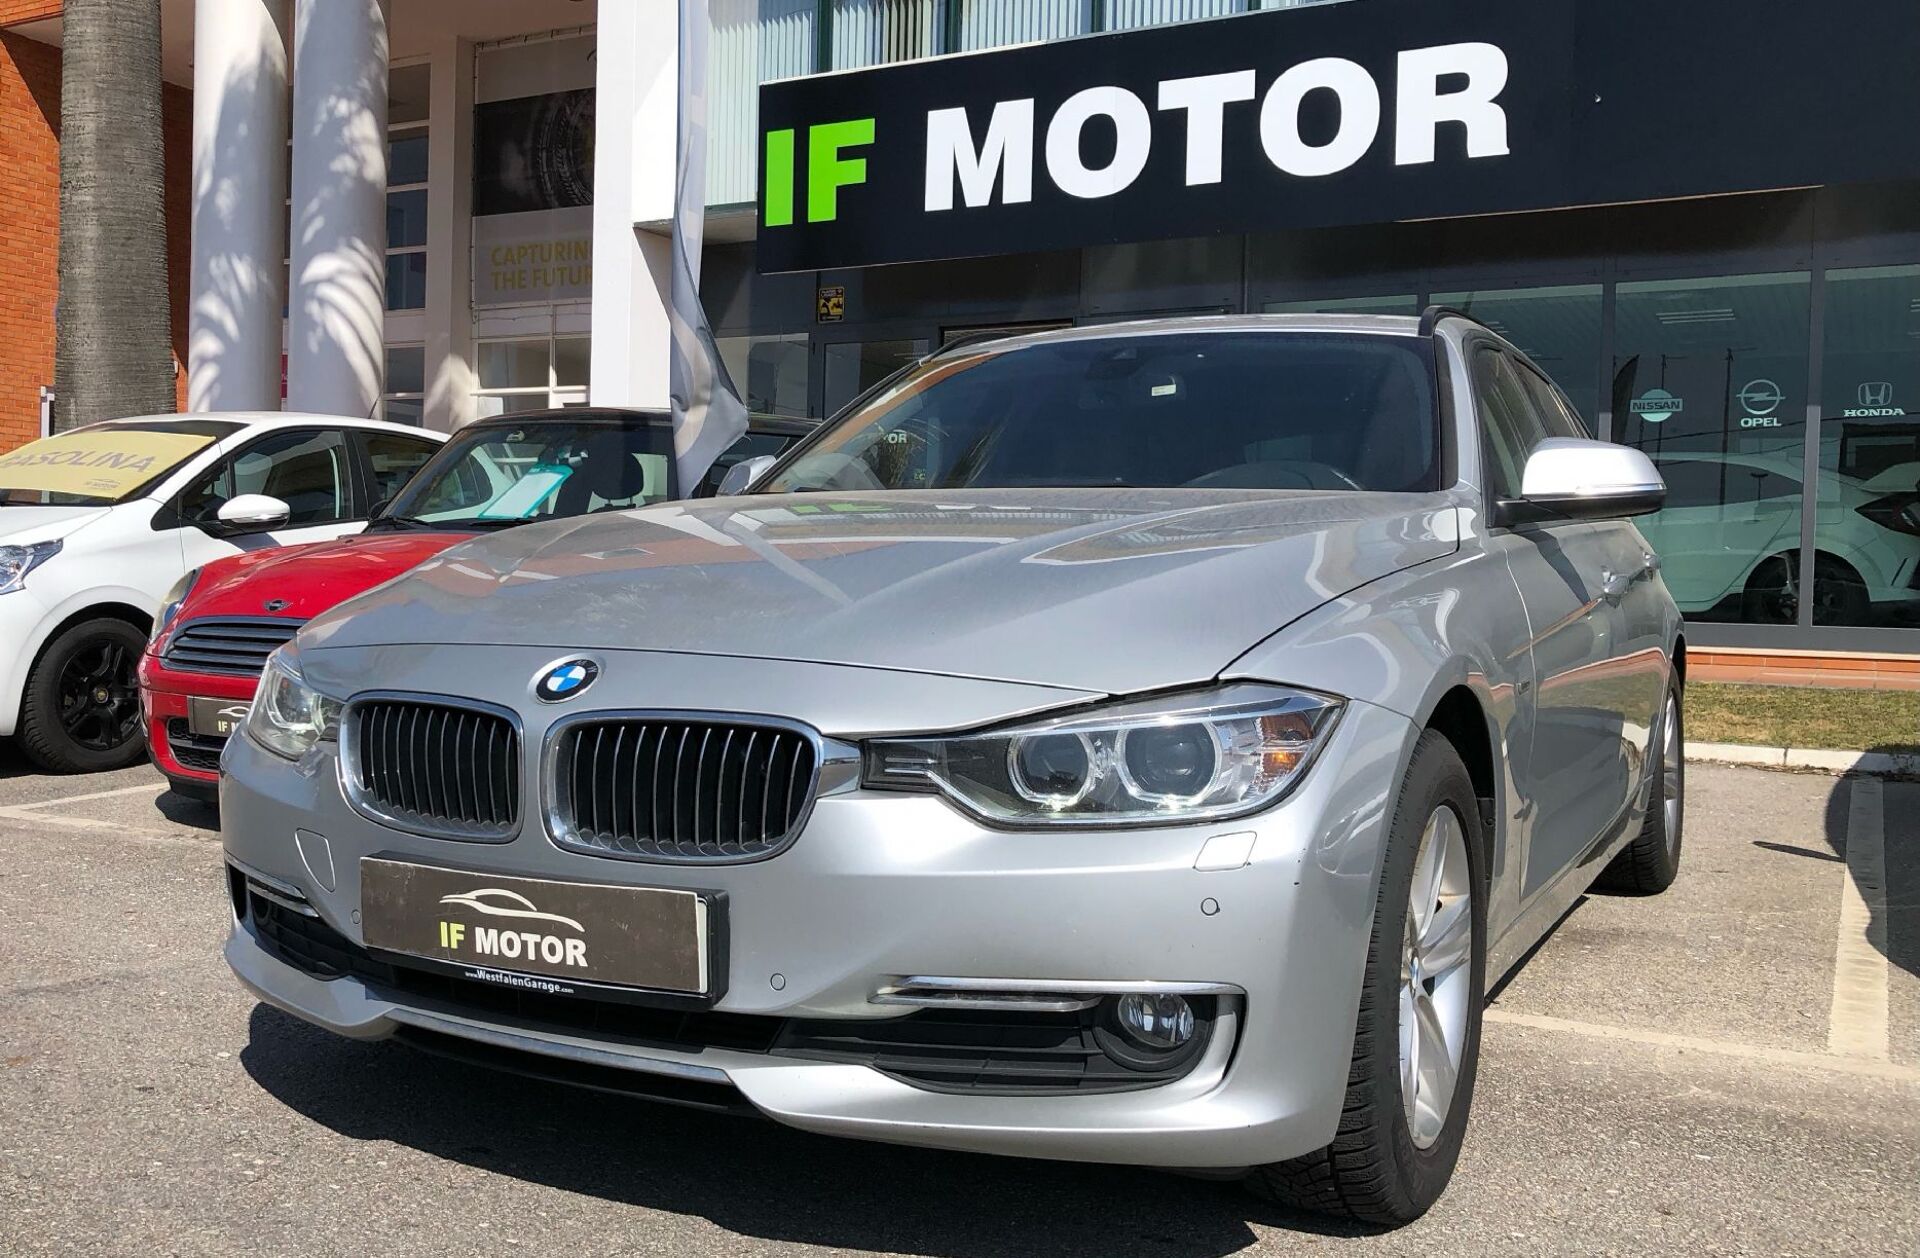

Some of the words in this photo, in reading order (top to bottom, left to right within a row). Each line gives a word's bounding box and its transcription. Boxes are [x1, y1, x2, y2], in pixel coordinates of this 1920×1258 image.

[765, 118, 875, 227] IF
[924, 42, 1510, 212] MOTOR
[490, 242, 592, 267] CAPTURIN
[490, 269, 528, 291] THE
[1632, 400, 1681, 411] NISSAN
[1843, 408, 1906, 417] HONDA
[1740, 417, 1782, 428] OPEL
[218, 720, 228, 733] IF
[440, 921, 466, 949] IF
[474, 926, 589, 967] MOTOR
